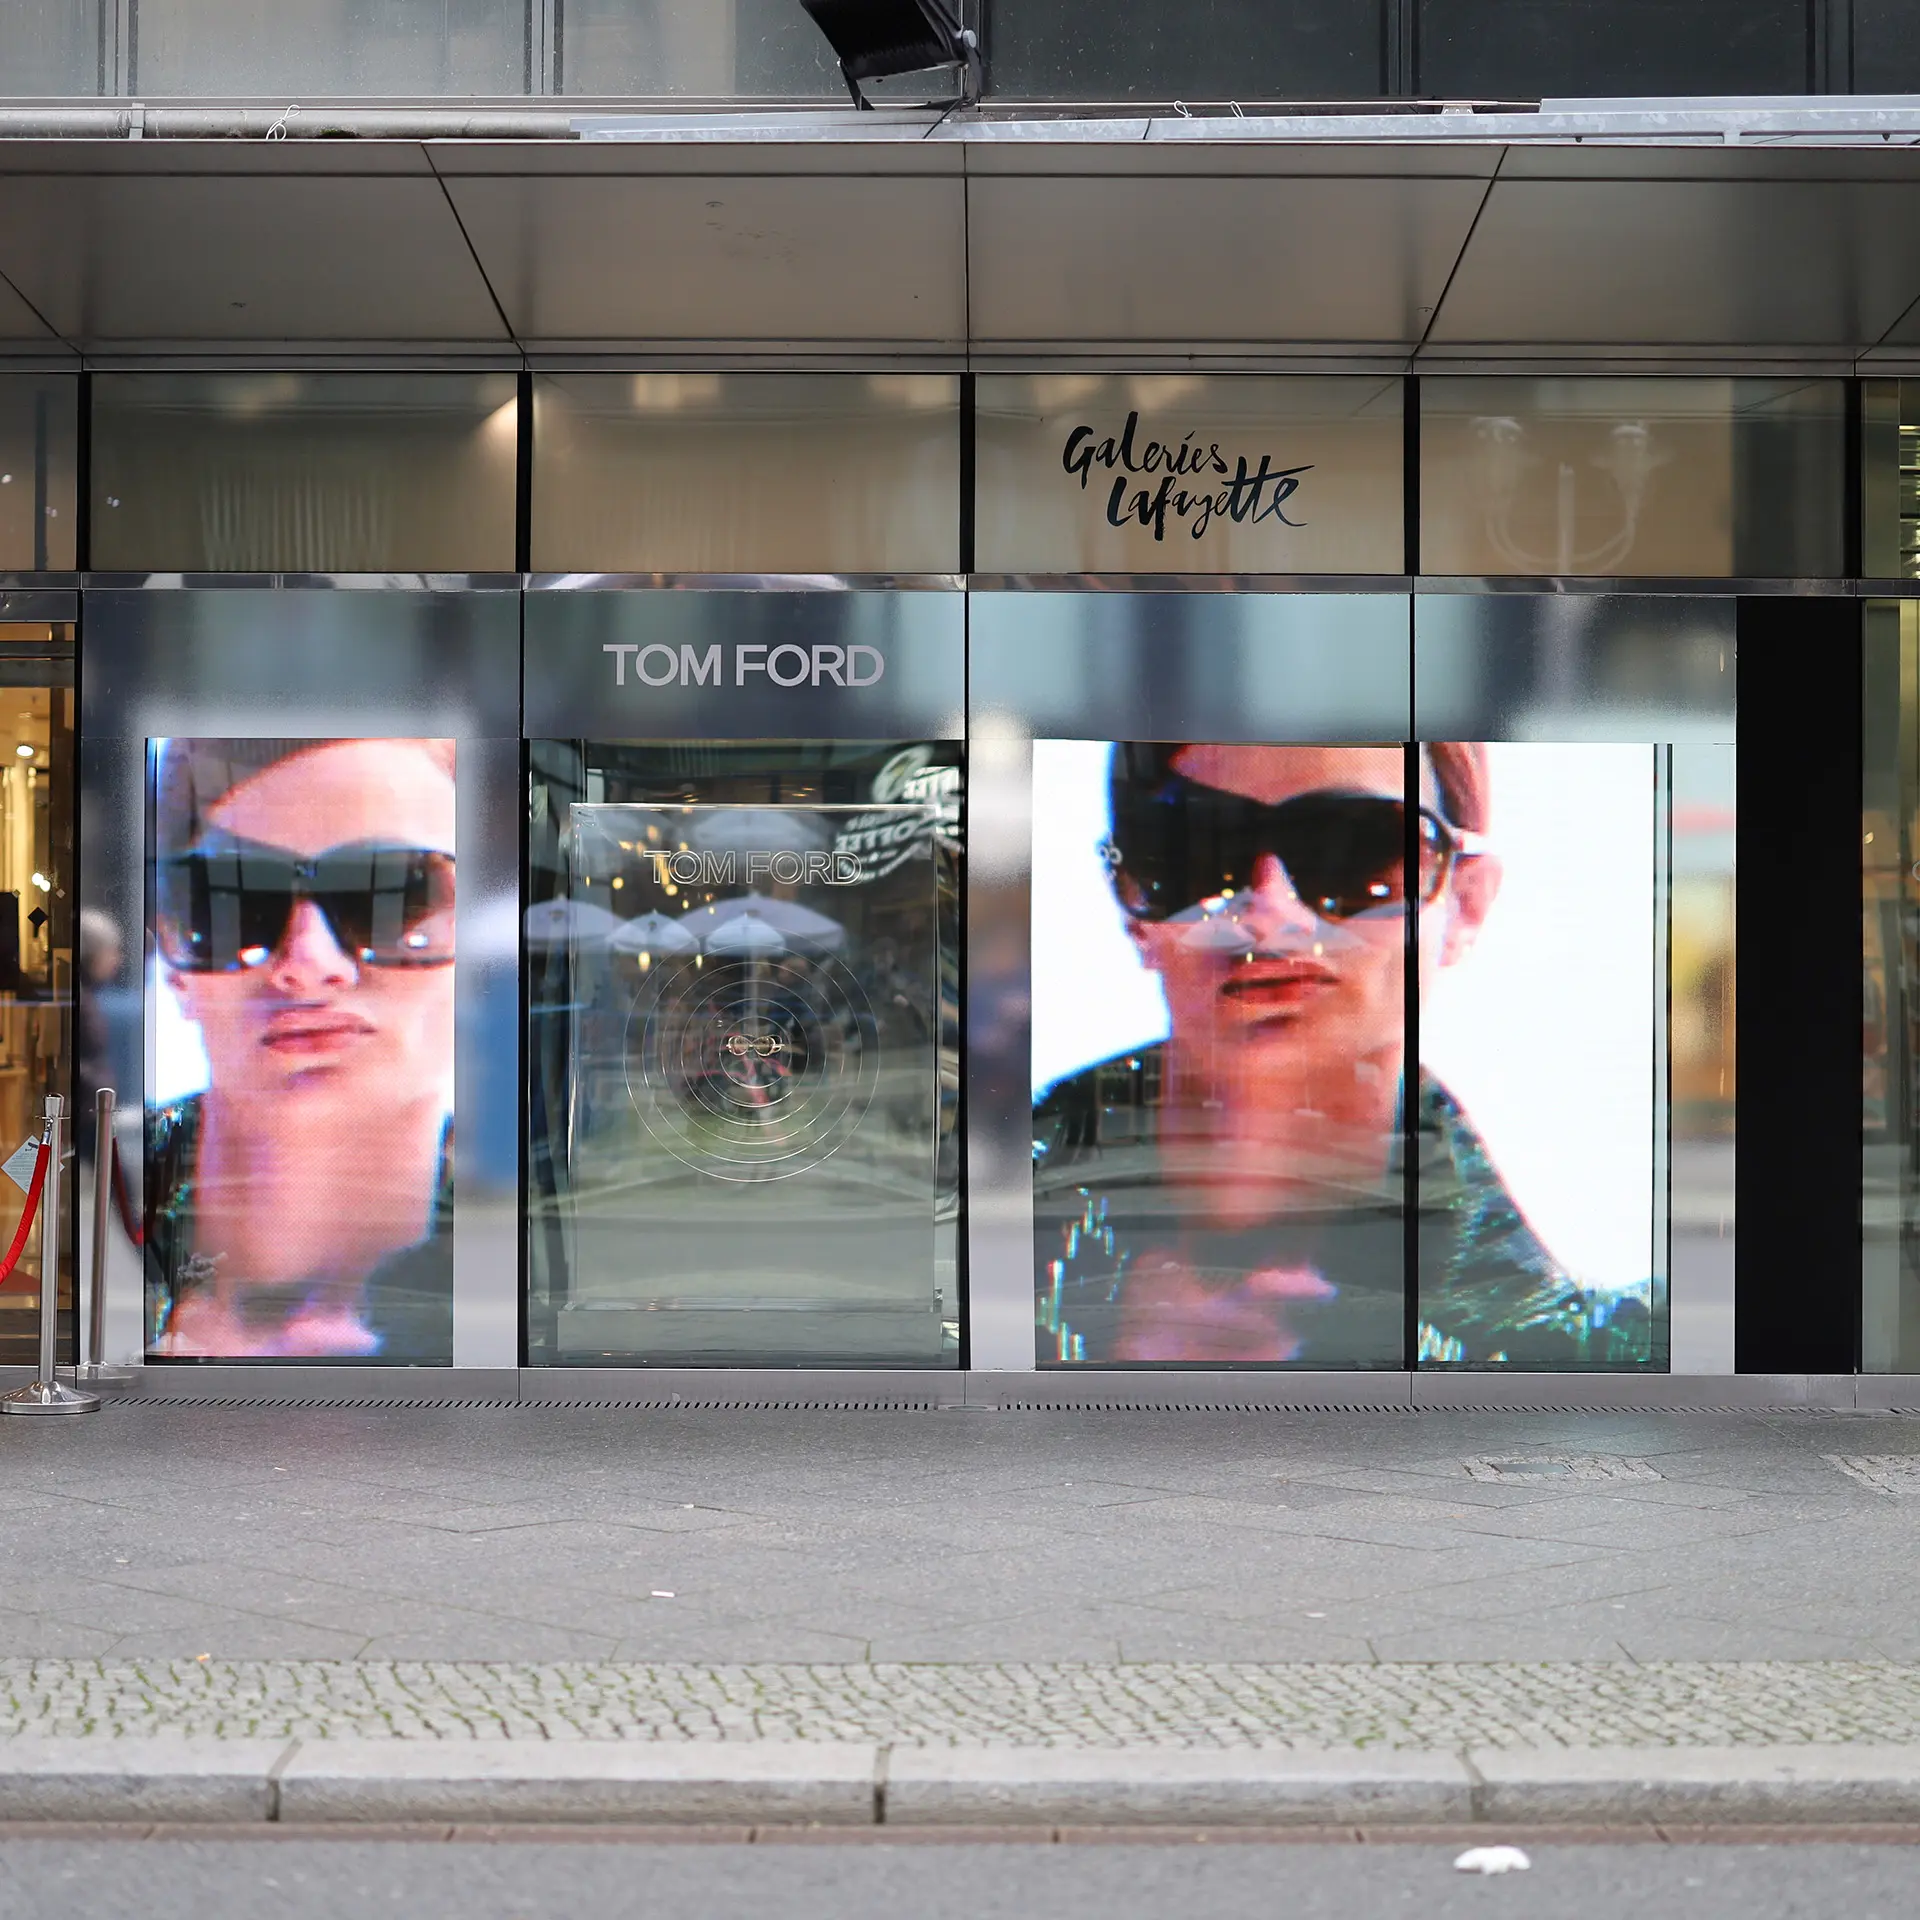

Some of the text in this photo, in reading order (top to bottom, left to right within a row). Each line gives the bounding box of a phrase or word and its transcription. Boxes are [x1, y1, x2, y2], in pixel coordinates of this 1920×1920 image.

[1062, 411, 1228, 489] Galeries
[1107, 455, 1315, 541] Lafayette
[602, 643, 885, 687] TOM FORD
[643, 850, 736, 885] TOM
[745, 850, 862, 885] FORD
